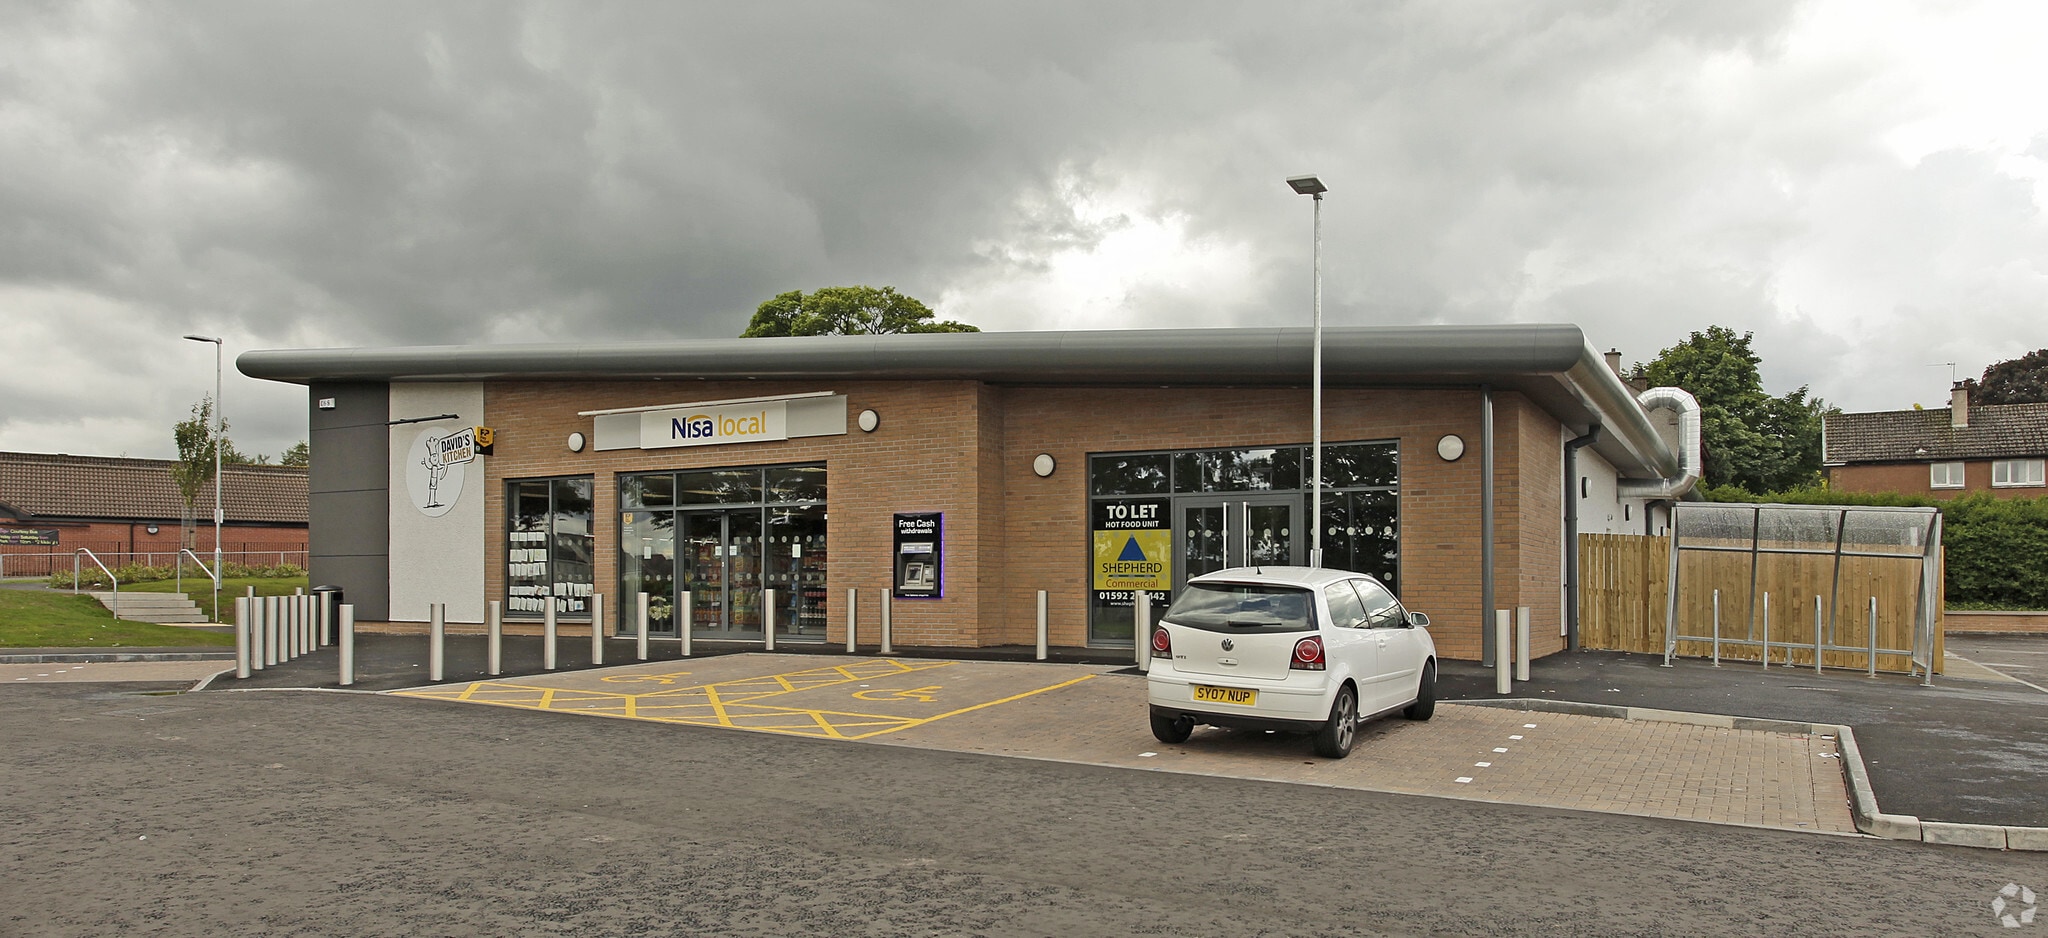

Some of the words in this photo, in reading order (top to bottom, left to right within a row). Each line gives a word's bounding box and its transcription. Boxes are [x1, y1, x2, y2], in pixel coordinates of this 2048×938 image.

[672, 415, 713, 439] Nisa
[718, 411, 766, 436] local
[441, 434, 471, 453] DAVID'S
[442, 447, 472, 463] KITCHEN
[1106, 504, 1127, 519] TO
[1130, 504, 1158, 519] LET
[899, 519, 915, 528] Free
[916, 519, 935, 528] Cash
[1142, 520, 1159, 528] UNIT
[1102, 562, 1162, 573] SHEPHERD
[1106, 579, 1158, 588] Commercial
[1099, 591, 1128, 600] 01592
[1130, 591, 1165, 601] 2442
[1197, 687, 1226, 700] SY07
[1228, 689, 1250, 703] NUP
